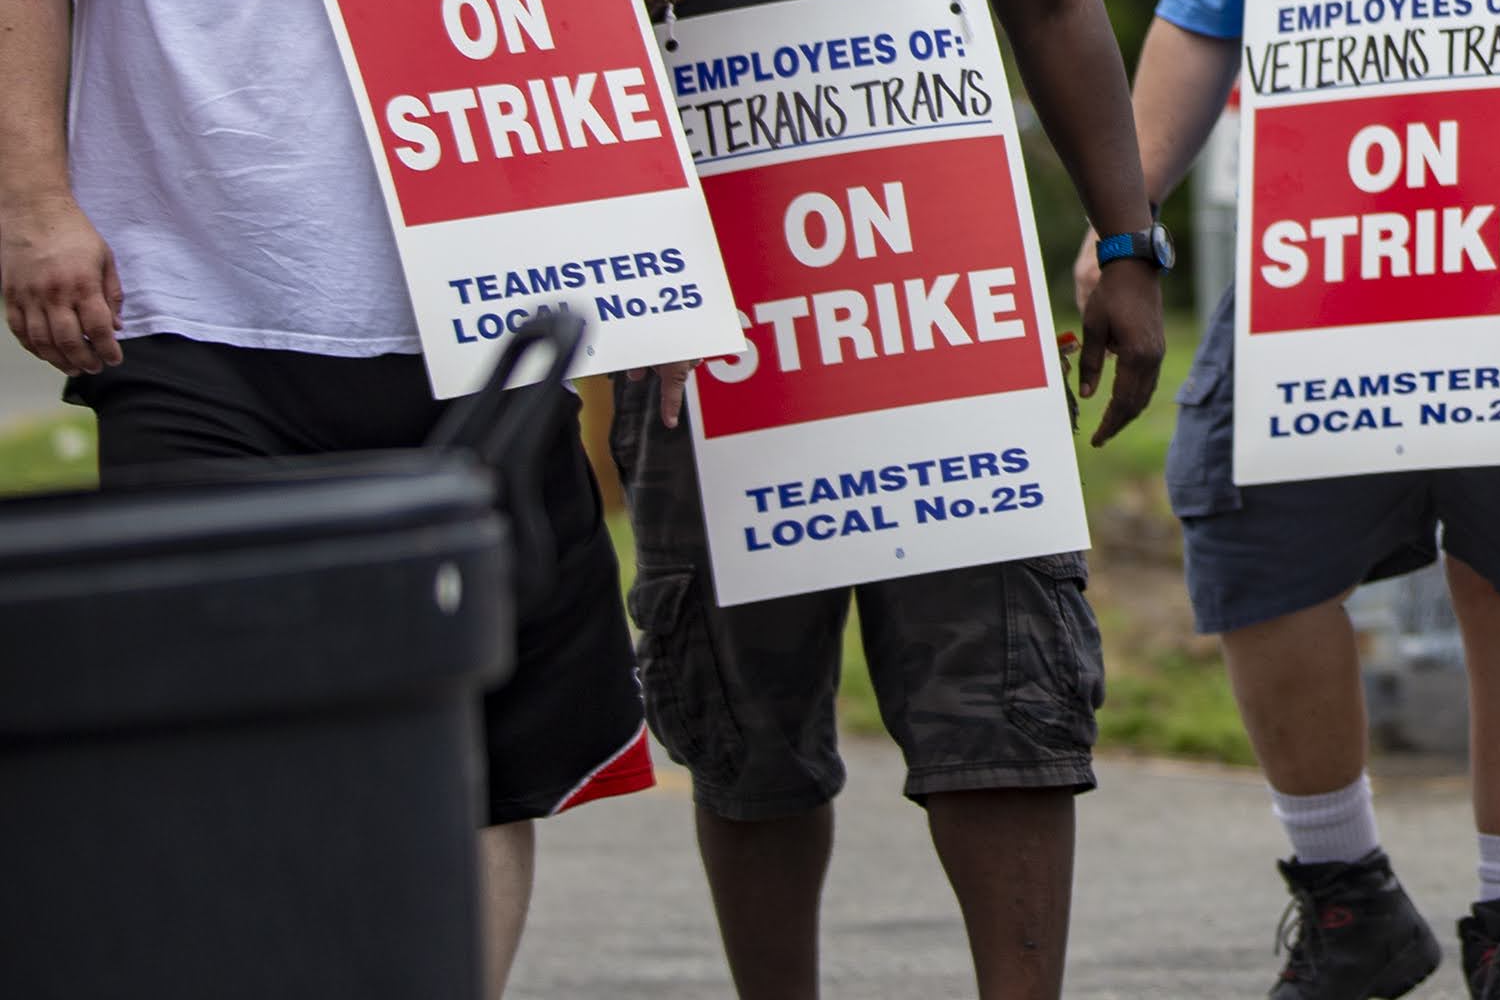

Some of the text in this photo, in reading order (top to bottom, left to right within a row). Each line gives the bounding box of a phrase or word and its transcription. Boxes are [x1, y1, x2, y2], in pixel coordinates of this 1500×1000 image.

[673, 29, 967, 97] EMPLOYEES OF:
[1246, 28, 1429, 95] VETERANS
[386, 67, 661, 172] STRIKE
[678, 68, 993, 159] ETERANS TRANS
[1348, 121, 1458, 193] ON
[784, 181, 913, 267] ON
[449, 248, 686, 304] TEAMSTERS
[452, 284, 703, 344] LOC No.25
[1270, 406, 1402, 437] LOCAL
[745, 448, 1030, 513] TEAMSTERS
[745, 483, 1044, 552] LOCAL No.25
